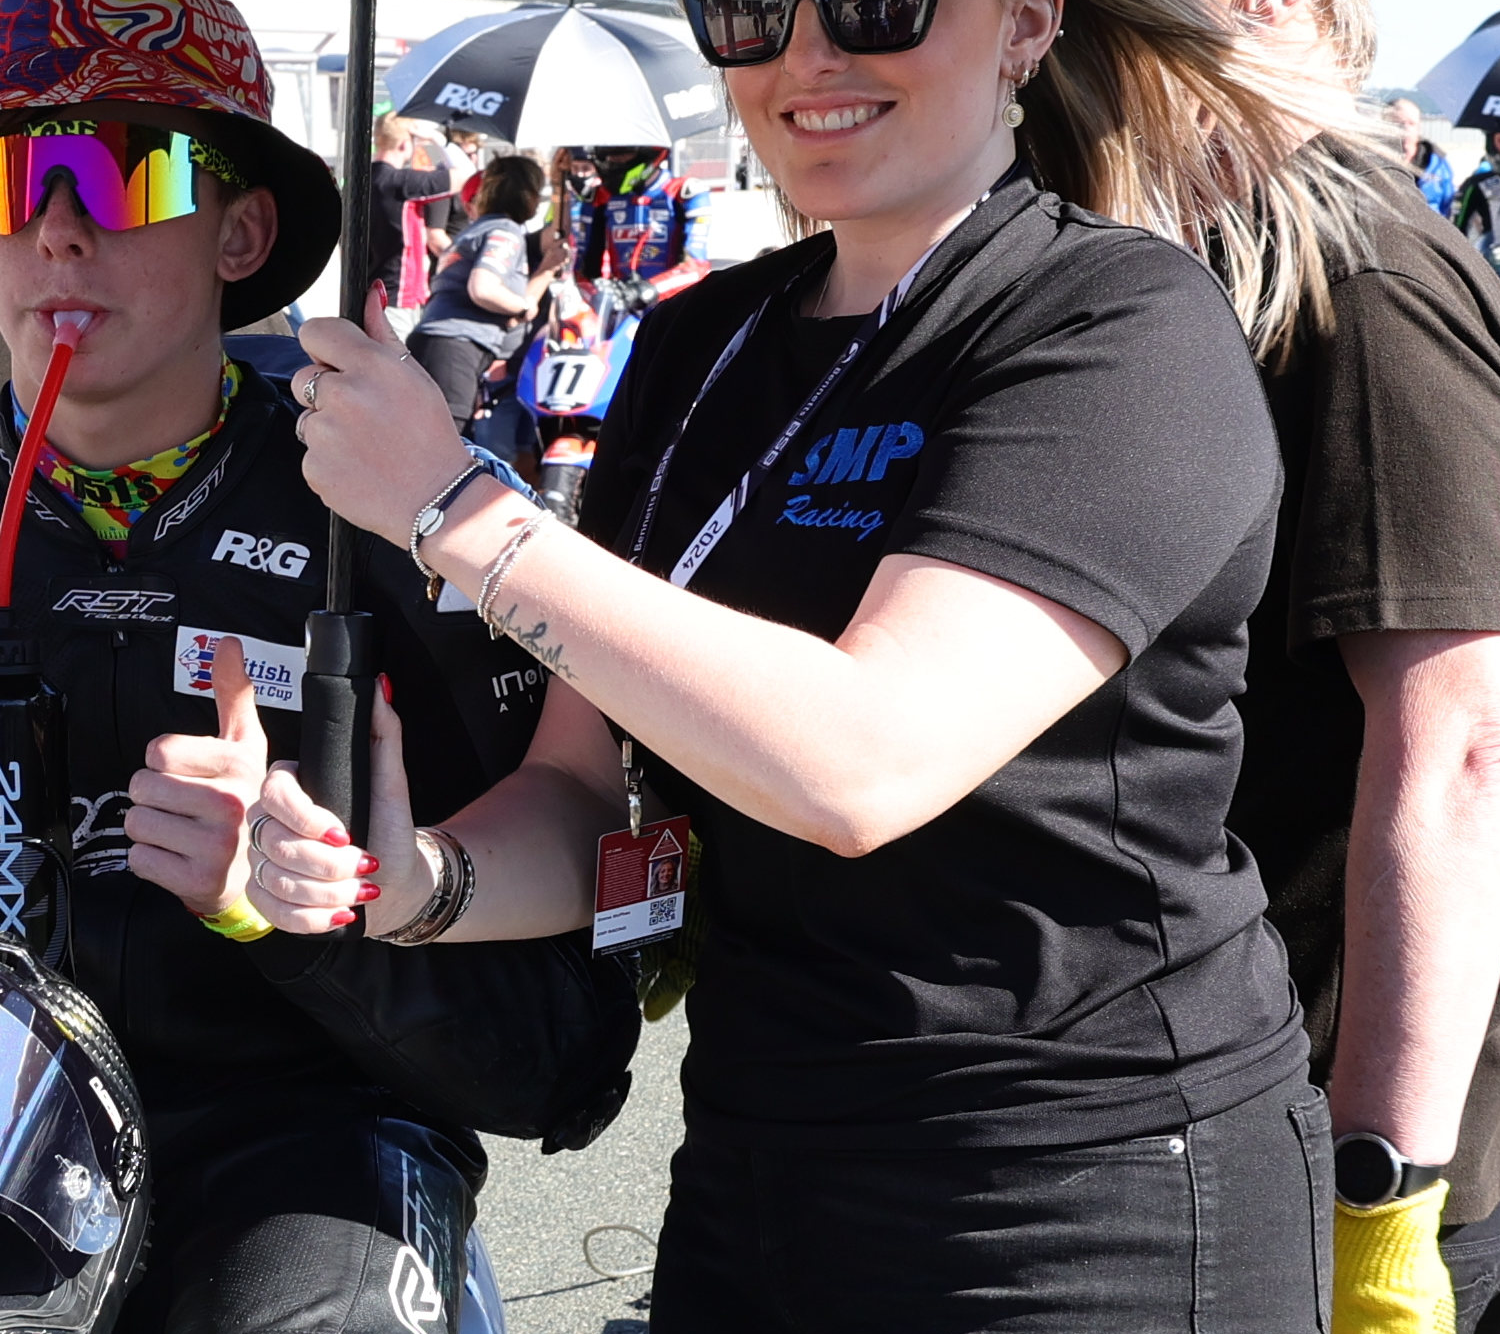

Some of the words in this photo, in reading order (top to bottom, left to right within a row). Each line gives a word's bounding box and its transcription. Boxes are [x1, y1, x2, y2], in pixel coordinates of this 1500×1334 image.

[434, 82, 504, 116] R&G
[546, 361, 586, 397] 11
[786, 420, 925, 487] SMP
[153, 442, 235, 542] RST
[634, 493, 658, 553] Bennetts
[775, 494, 885, 543] Racing
[211, 529, 311, 579] R&G
[681, 519, 724, 571] 2024
[52, 589, 176, 613] RST
[244, 657, 292, 684] itish
[267, 686, 293, 701] Cup
